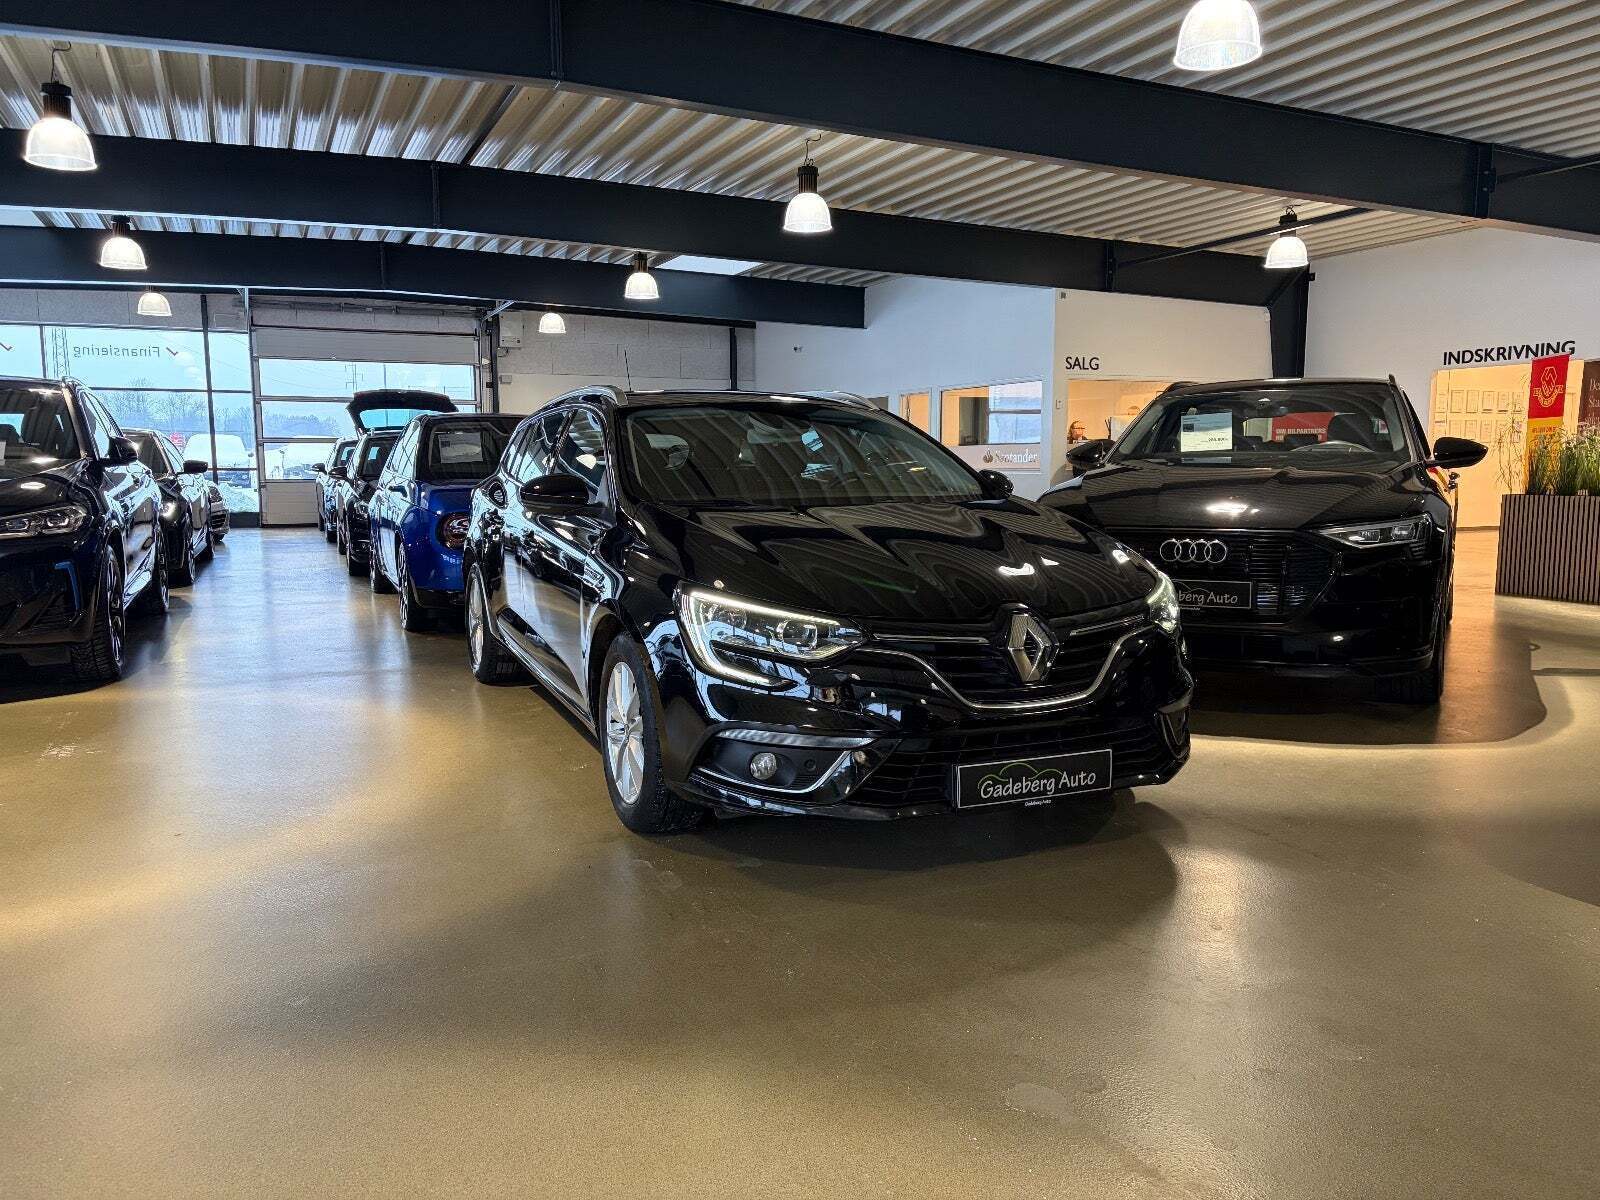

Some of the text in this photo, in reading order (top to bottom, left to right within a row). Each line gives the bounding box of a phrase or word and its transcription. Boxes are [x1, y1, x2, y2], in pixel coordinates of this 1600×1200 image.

[1443, 340, 1576, 366] INDSKRIVNING
[1065, 356, 1100, 371] SALG
[1207, 592, 1238, 604] Auto
[980, 771, 1097, 799] Gadeberg Auto
